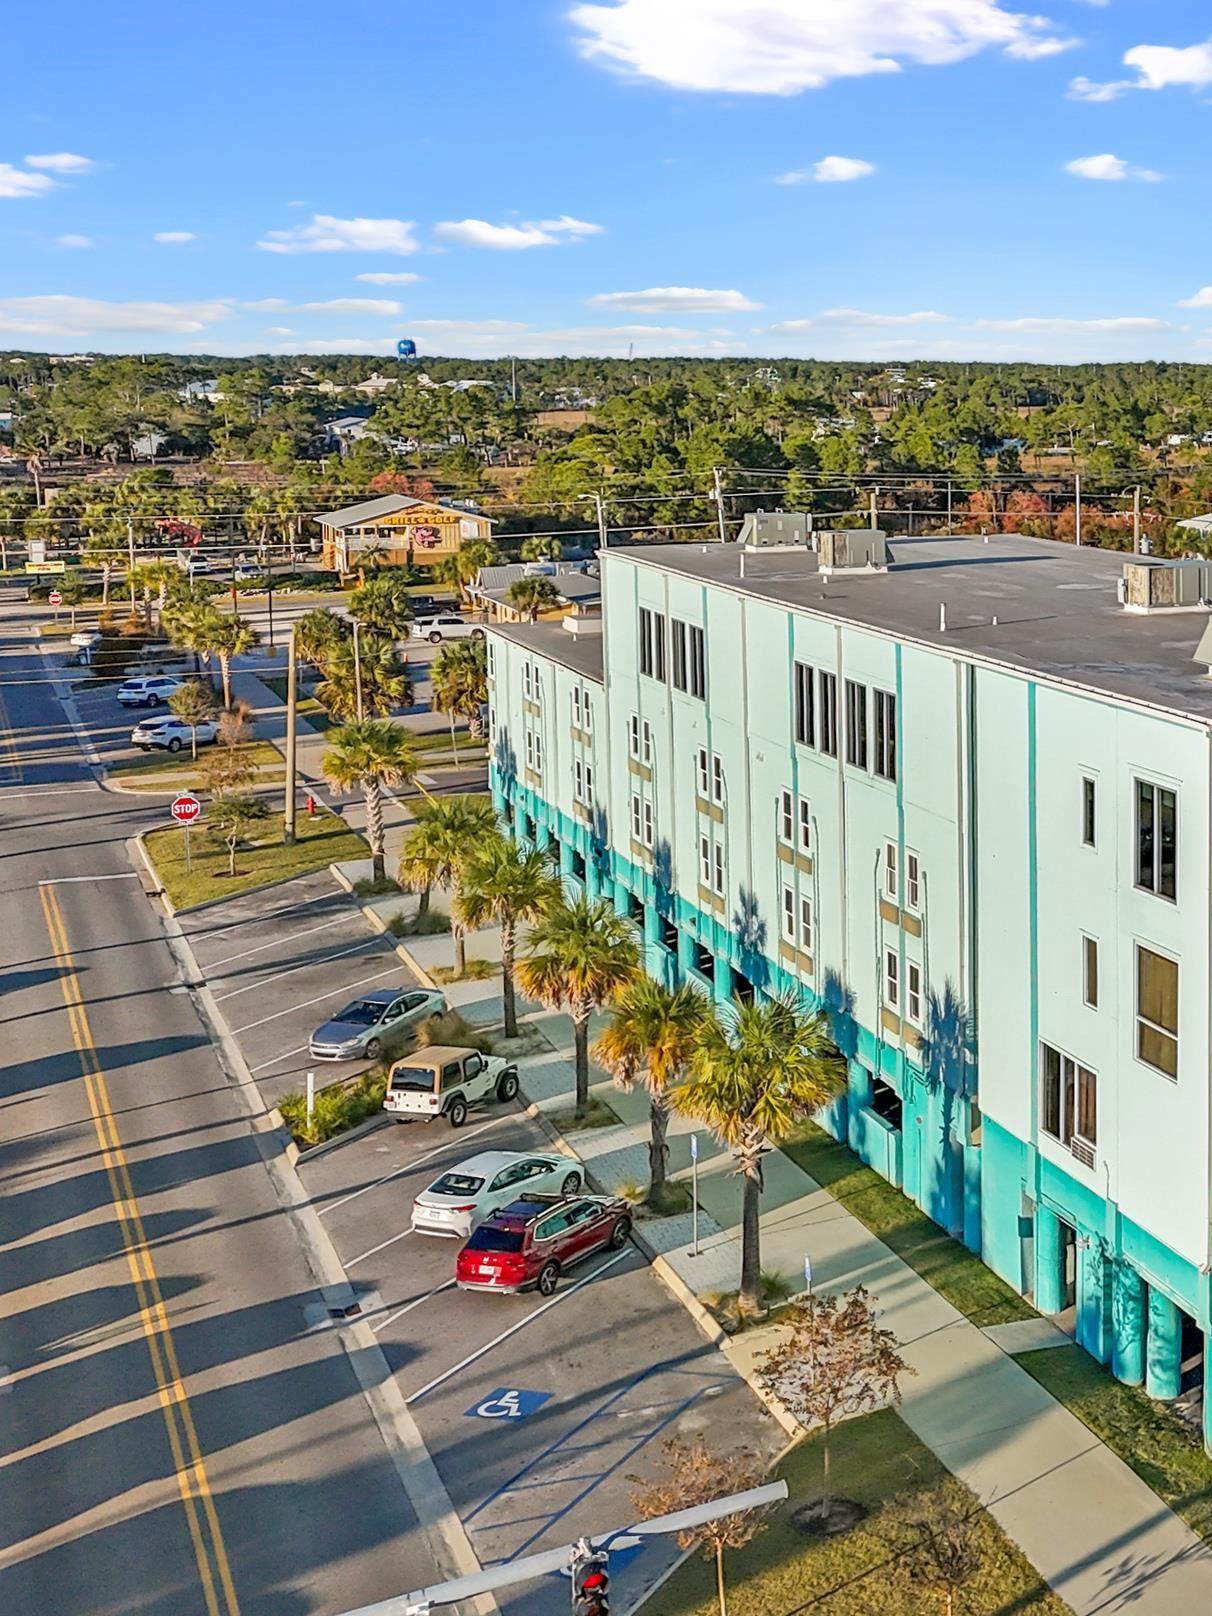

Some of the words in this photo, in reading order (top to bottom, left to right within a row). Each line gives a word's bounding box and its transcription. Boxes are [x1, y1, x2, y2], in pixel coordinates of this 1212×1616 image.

[384, 517, 417, 525] GRILL
[427, 516, 457, 524] GOLF
[174, 804, 197, 814] STOP
